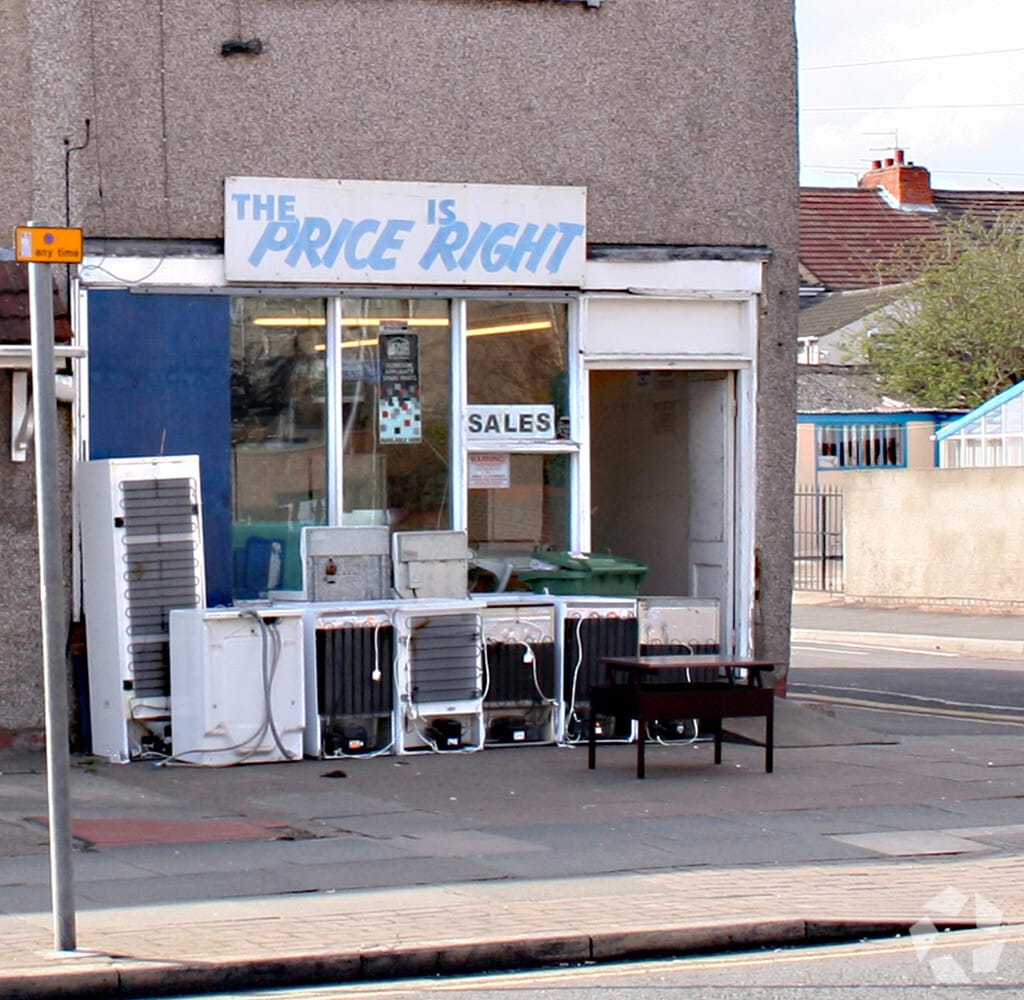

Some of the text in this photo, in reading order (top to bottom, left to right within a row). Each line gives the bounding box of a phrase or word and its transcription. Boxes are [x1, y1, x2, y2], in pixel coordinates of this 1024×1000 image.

[231, 193, 585, 274] THE PRICE IS RIGHT
[468, 413, 551, 433] SALES
